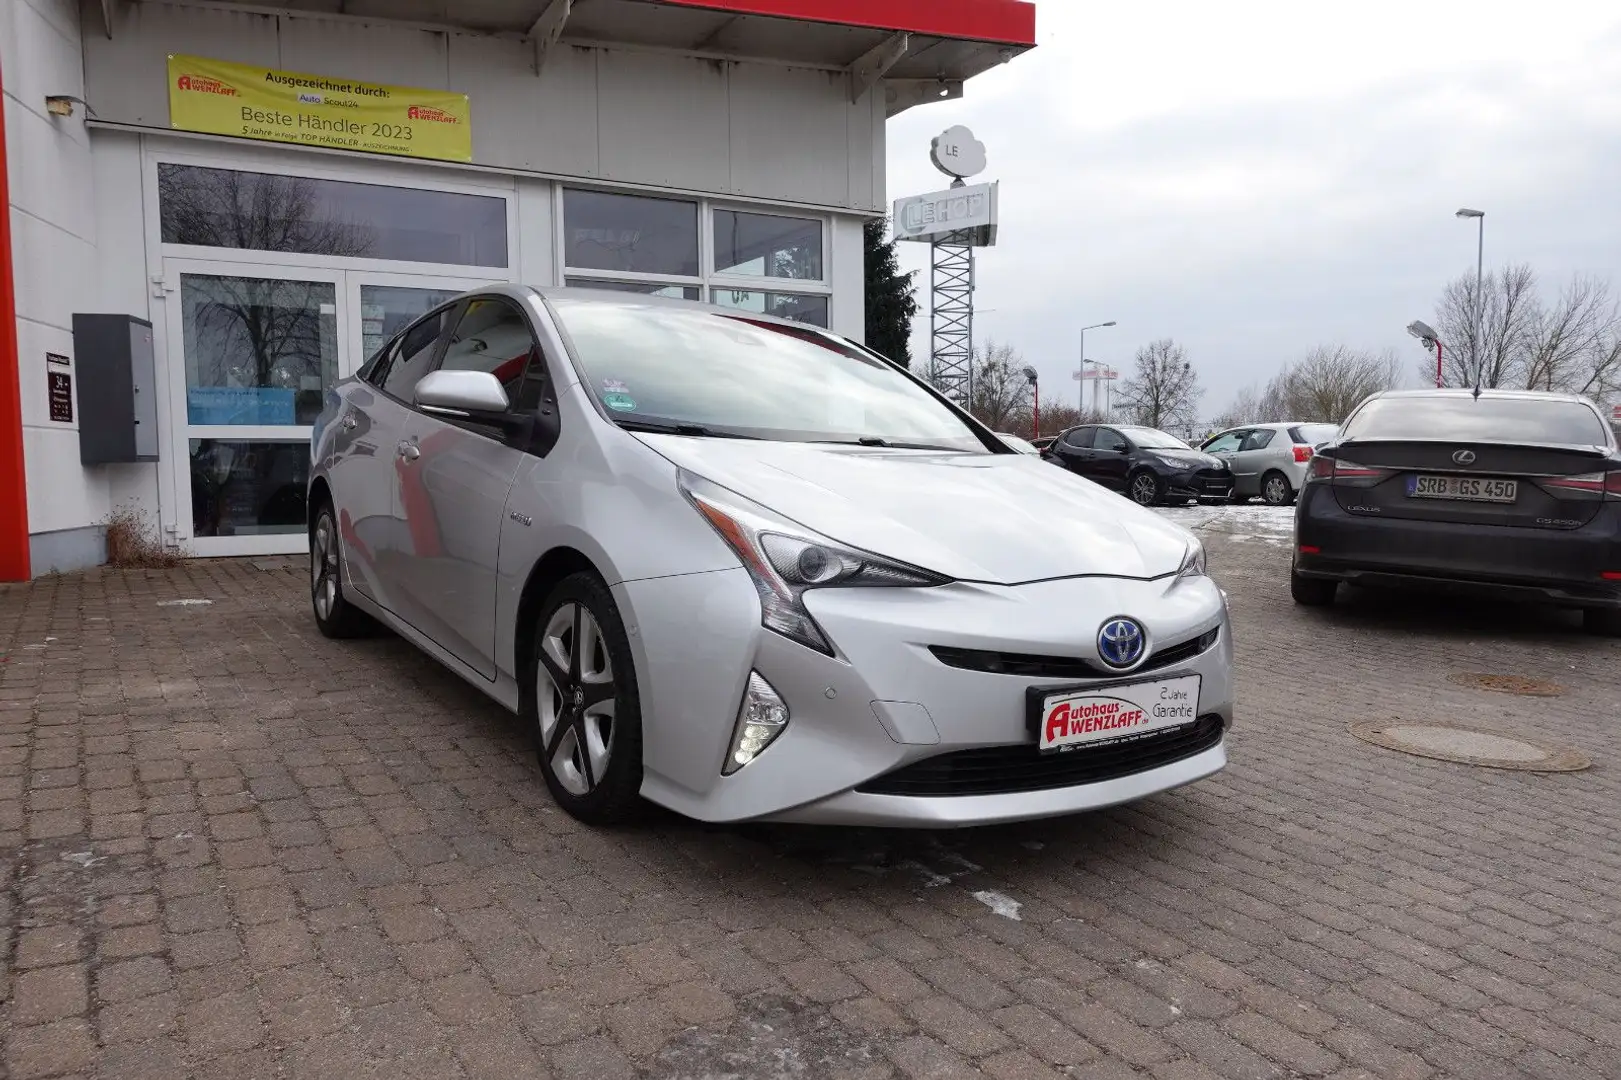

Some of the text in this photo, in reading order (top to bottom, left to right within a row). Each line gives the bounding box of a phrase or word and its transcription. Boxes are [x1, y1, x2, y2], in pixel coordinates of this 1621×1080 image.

[265, 71, 391, 99] Ausgezeichnet durch:
[299, 93, 359, 109] Auto Scout24
[241, 106, 414, 141] Beste Händler 2023
[241, 125, 249, 135] 5
[301, 133, 318, 142] TOP
[945, 144, 959, 157] LE
[1417, 478, 1516, 499] SRB GS 450
[1160, 687, 1188, 700] 2 Jahre
[1152, 702, 1193, 718] Garantie
[1070, 710, 1143, 735] WENZLAFF
